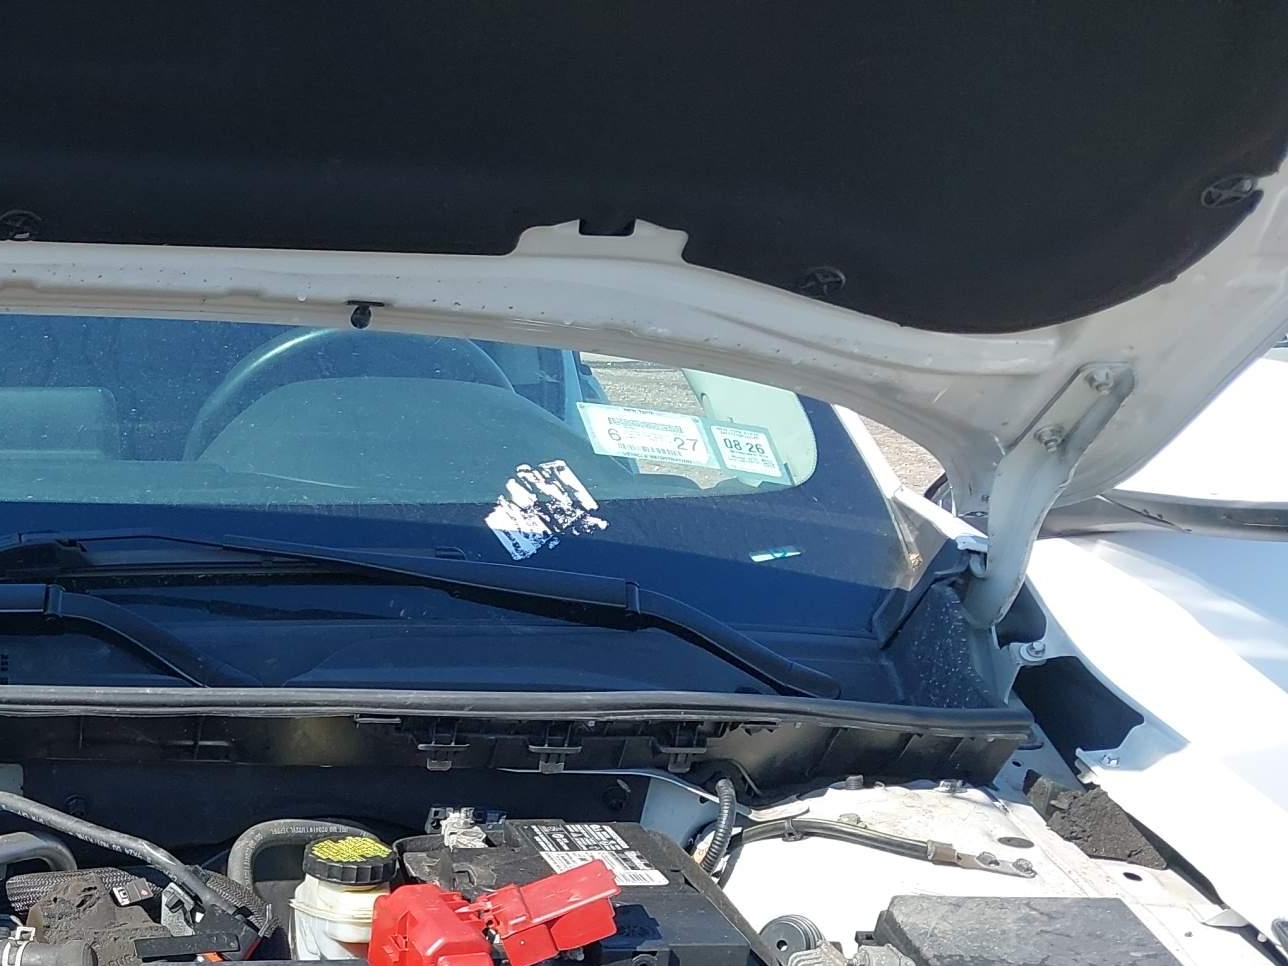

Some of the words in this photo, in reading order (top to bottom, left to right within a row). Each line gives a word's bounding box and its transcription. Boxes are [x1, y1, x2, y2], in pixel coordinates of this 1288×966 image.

[608, 428, 622, 441] 6
[673, 436, 699, 452] 27
[722, 437, 742, 452] 08
[746, 441, 766, 455] 26
